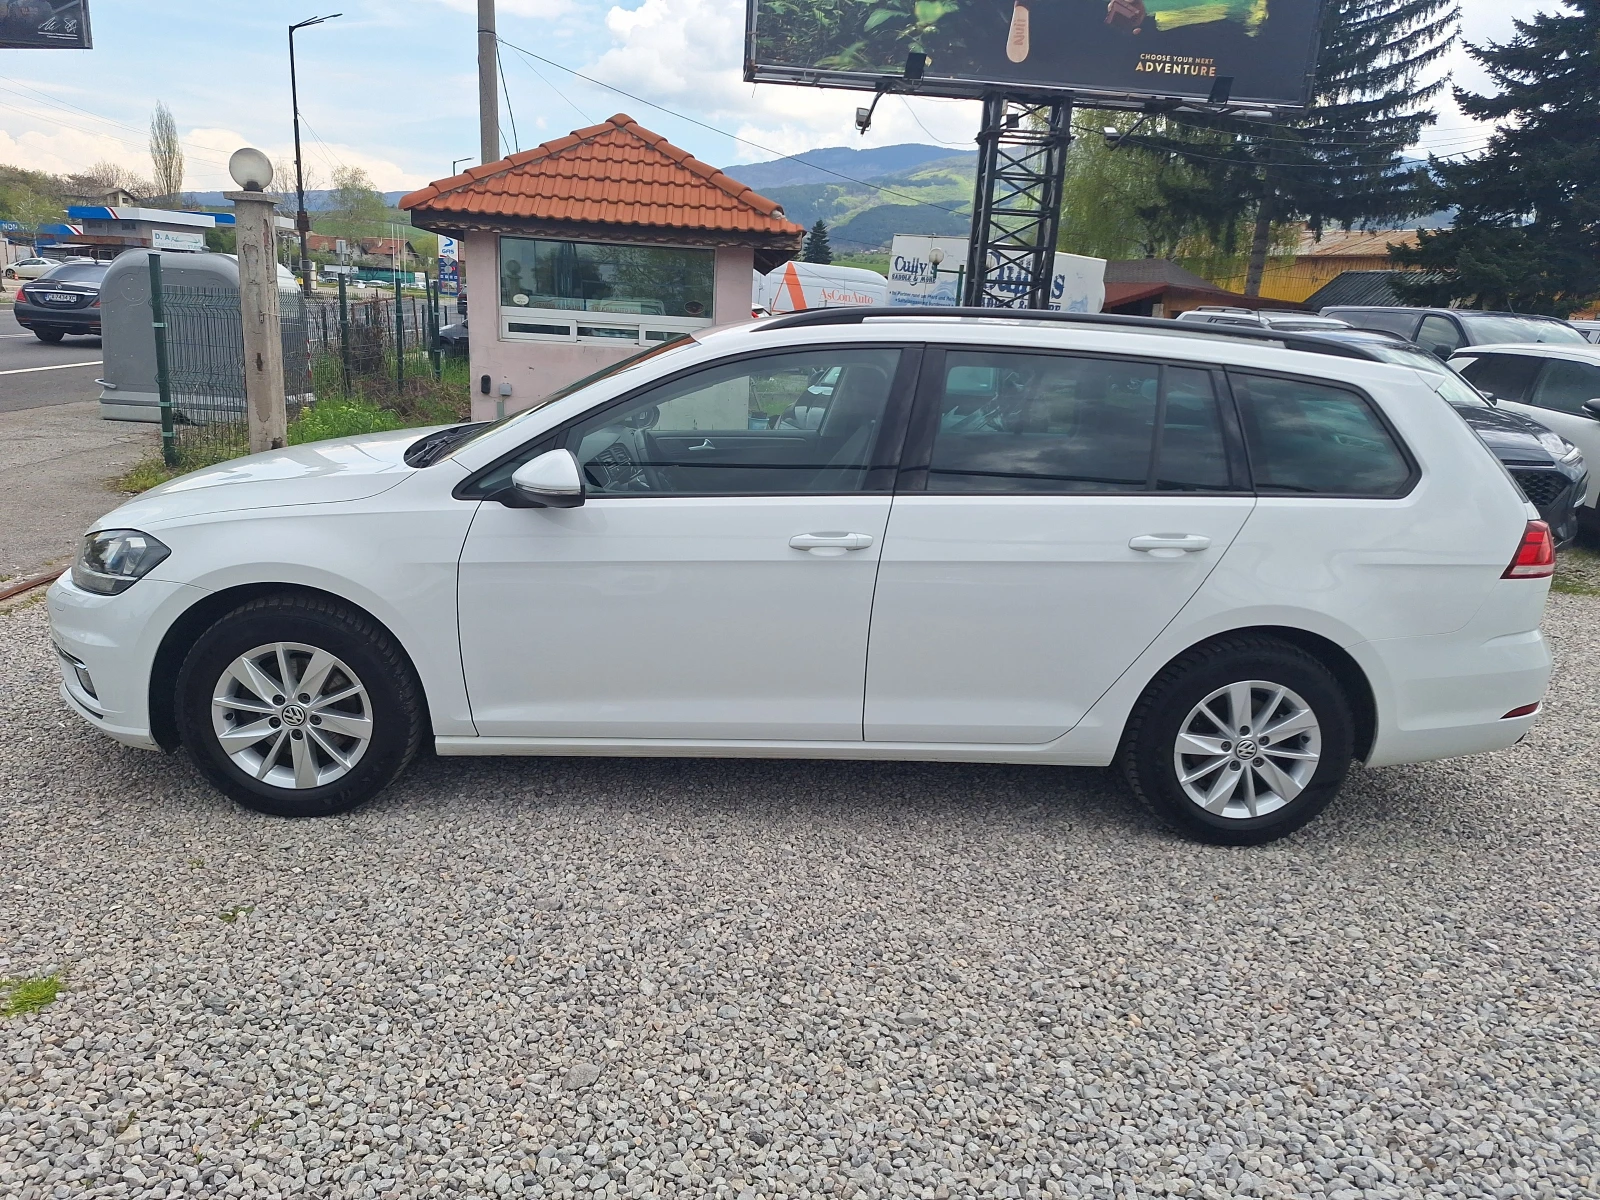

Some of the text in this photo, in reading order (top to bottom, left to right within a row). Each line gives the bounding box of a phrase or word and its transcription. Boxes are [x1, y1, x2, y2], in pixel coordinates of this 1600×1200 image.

[1140, 53, 1214, 65] CHOOSE YOUR NEXT
[1135, 61, 1217, 77] ADVENTURE
[891, 273, 912, 281] SADDLE
[818, 287, 874, 304] AsConAuto
